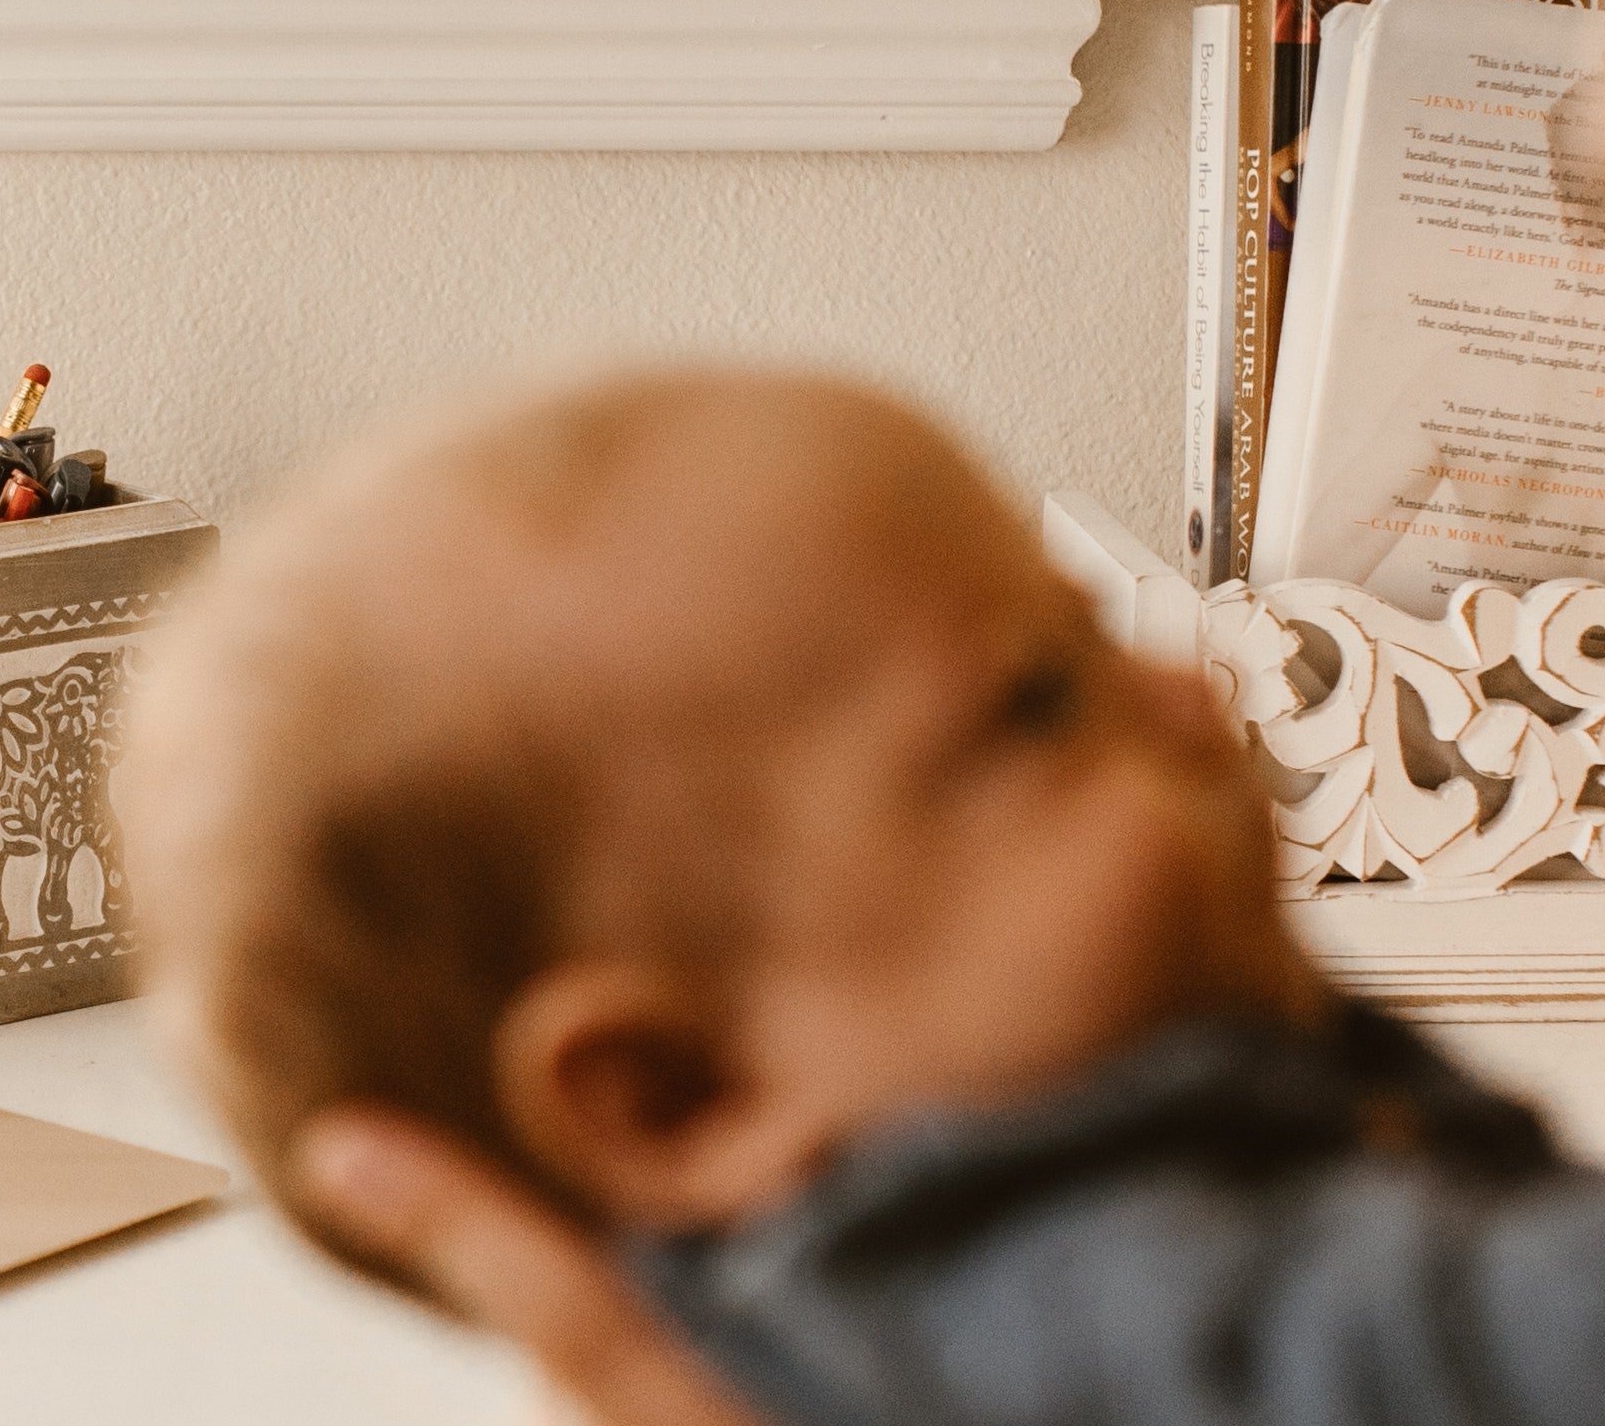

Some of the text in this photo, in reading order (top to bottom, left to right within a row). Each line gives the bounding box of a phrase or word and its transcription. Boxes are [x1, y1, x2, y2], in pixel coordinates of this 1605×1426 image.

[1534, 61, 1560, 78] kind
[1195, 43, 1215, 153] Breaking
[1490, 79, 1541, 98] midnight
[1430, 130, 1454, 144] read
[1457, 131, 1504, 151] Amanda
[1406, 145, 1456, 169] headlong
[1197, 163, 1212, 201] the
[1244, 148, 1261, 221] POP
[1402, 168, 1434, 184] world
[1463, 174, 1509, 194] Amanda
[1513, 181, 1551, 200] Palmer
[1438, 195, 1461, 208] read
[1509, 203, 1557, 225] doorway
[1560, 214, 1592, 228] opens
[1194, 208, 1211, 277] Habit
[1426, 215, 1459, 229] world
[1461, 221, 1500, 238] exactly
[1559, 231, 1584, 247] God
[1195, 285, 1209, 311] of
[1241, 229, 1260, 399] CULTURE
[1407, 291, 1459, 311] “Amanda
[1462, 299, 1481, 314] has
[1493, 303, 1526, 320] direct
[1528, 308, 1549, 324] line
[1553, 314, 1578, 328] with
[1581, 316, 1599, 331] her
[1417, 314, 1435, 329] the
[1438, 318, 1517, 344] codependency
[1520, 329, 1534, 343] all
[1537, 333, 1563, 350] truly
[1567, 339, 1595, 352] great
[1190, 320, 1207, 391] Being
[1530, 353, 1582, 371] incapable
[1420, 417, 1452, 433] where
[1455, 423, 1490, 438] media
[1459, 404, 1485, 420] story
[1490, 406, 1520, 422] about
[1191, 402, 1207, 496] Yourself
[1238, 409, 1253, 500] ARAB
[1439, 440, 1476, 458] digital
[1503, 449, 1521, 464] for
[1522, 455, 1567, 474] aspiring
[1570, 462, 1604, 475] artists
[1447, 501, 1486, 519] Palmer
[1488, 509, 1533, 529] joyfully
[1535, 514, 1568, 530] shows
[1511, 537, 1548, 553] author
[1565, 542, 1591, 559] How
